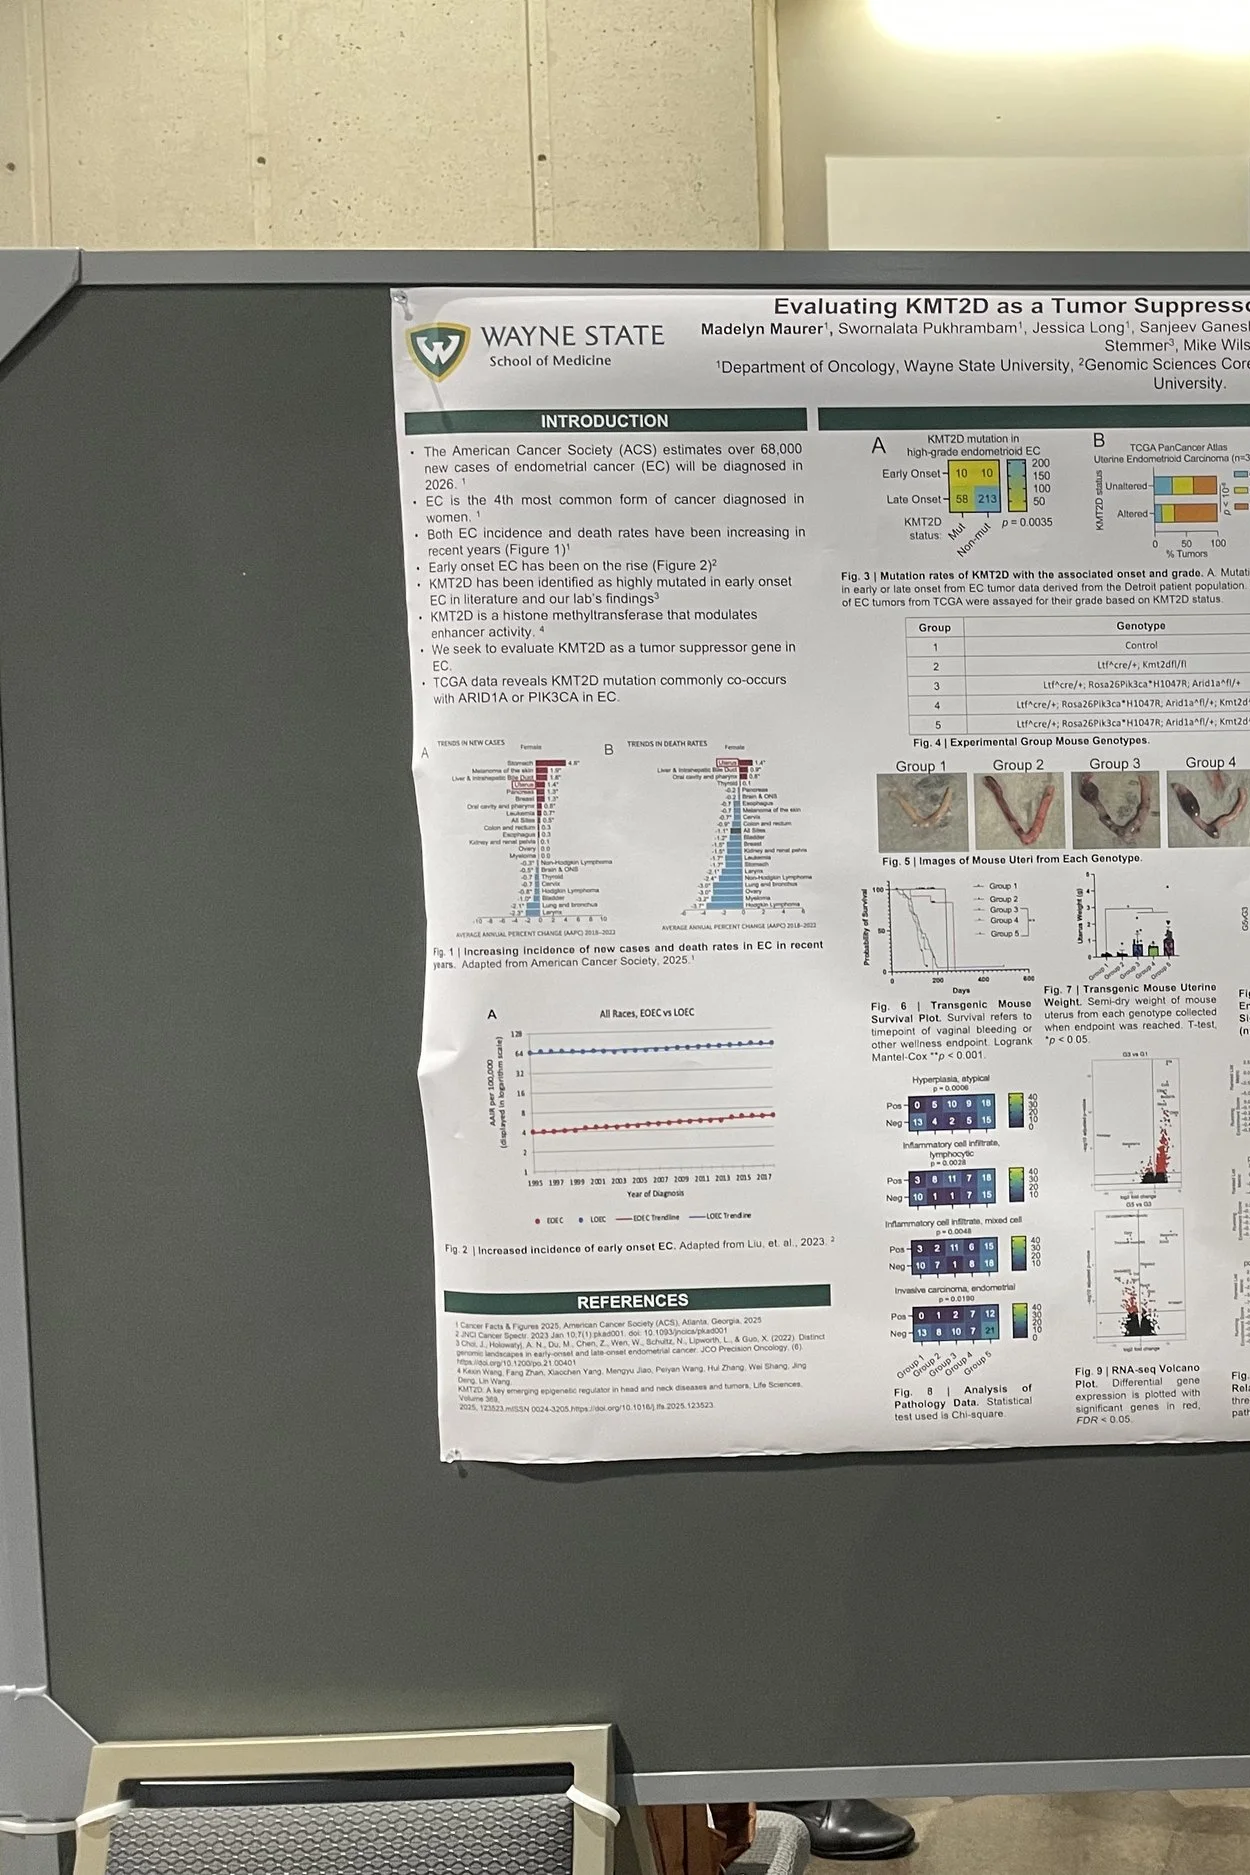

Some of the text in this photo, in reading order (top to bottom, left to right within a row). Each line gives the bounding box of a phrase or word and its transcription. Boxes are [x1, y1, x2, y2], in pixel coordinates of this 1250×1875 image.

[774, 297, 896, 319] Evaluating
[906, 297, 988, 314] KMT2D
[996, 301, 1022, 314] as
[1031, 301, 1043, 314] a
[1051, 297, 1127, 313] Tumor
[480, 324, 664, 347] WAYNE STATE
[701, 321, 764, 338] Madelyn
[838, 321, 917, 334] Swornalata
[1032, 321, 1084, 333] Jessica
[1139, 320, 1196, 336] Sanjeev
[1183, 338, 1216, 351] Mike
[489, 354, 611, 367] School of Medicine
[809, 359, 824, 373] of
[827, 359, 899, 376] Oncology,
[903, 359, 954, 375] Wayne
[958, 358, 995, 372] State
[1000, 358, 1073, 374] University,
[1152, 357, 1216, 370] Sciences
[1153, 376, 1226, 392] University.
[541, 413, 668, 428] INTRODUCTION
[423, 442, 802, 458] The American Cancer Society (ACS) estimates over 68,000
[424, 459, 803, 474] new cases of endometrial cancer (EC) will be diagnosed in
[918, 622, 951, 634] Group
[1116, 621, 1165, 632] Genotype
[1125, 640, 1157, 649] Control
[433, 674, 786, 688] TCGA data reveals KMT2D mutation commonly co-occurs
[895, 760, 947, 774] Group 1
[993, 759, 1044, 773] Group 2
[1089, 757, 1141, 771] Group 3
[1185, 755, 1236, 770] Group 4
[462, 1245, 467, 1254] 2
[478, 1245, 527, 1255] Increased
[530, 1244, 581, 1254] incidence
[584, 1243, 594, 1252] of
[597, 1243, 623, 1254] early
[625, 1243, 655, 1252] onset
[577, 1293, 688, 1309] REFERENCES
